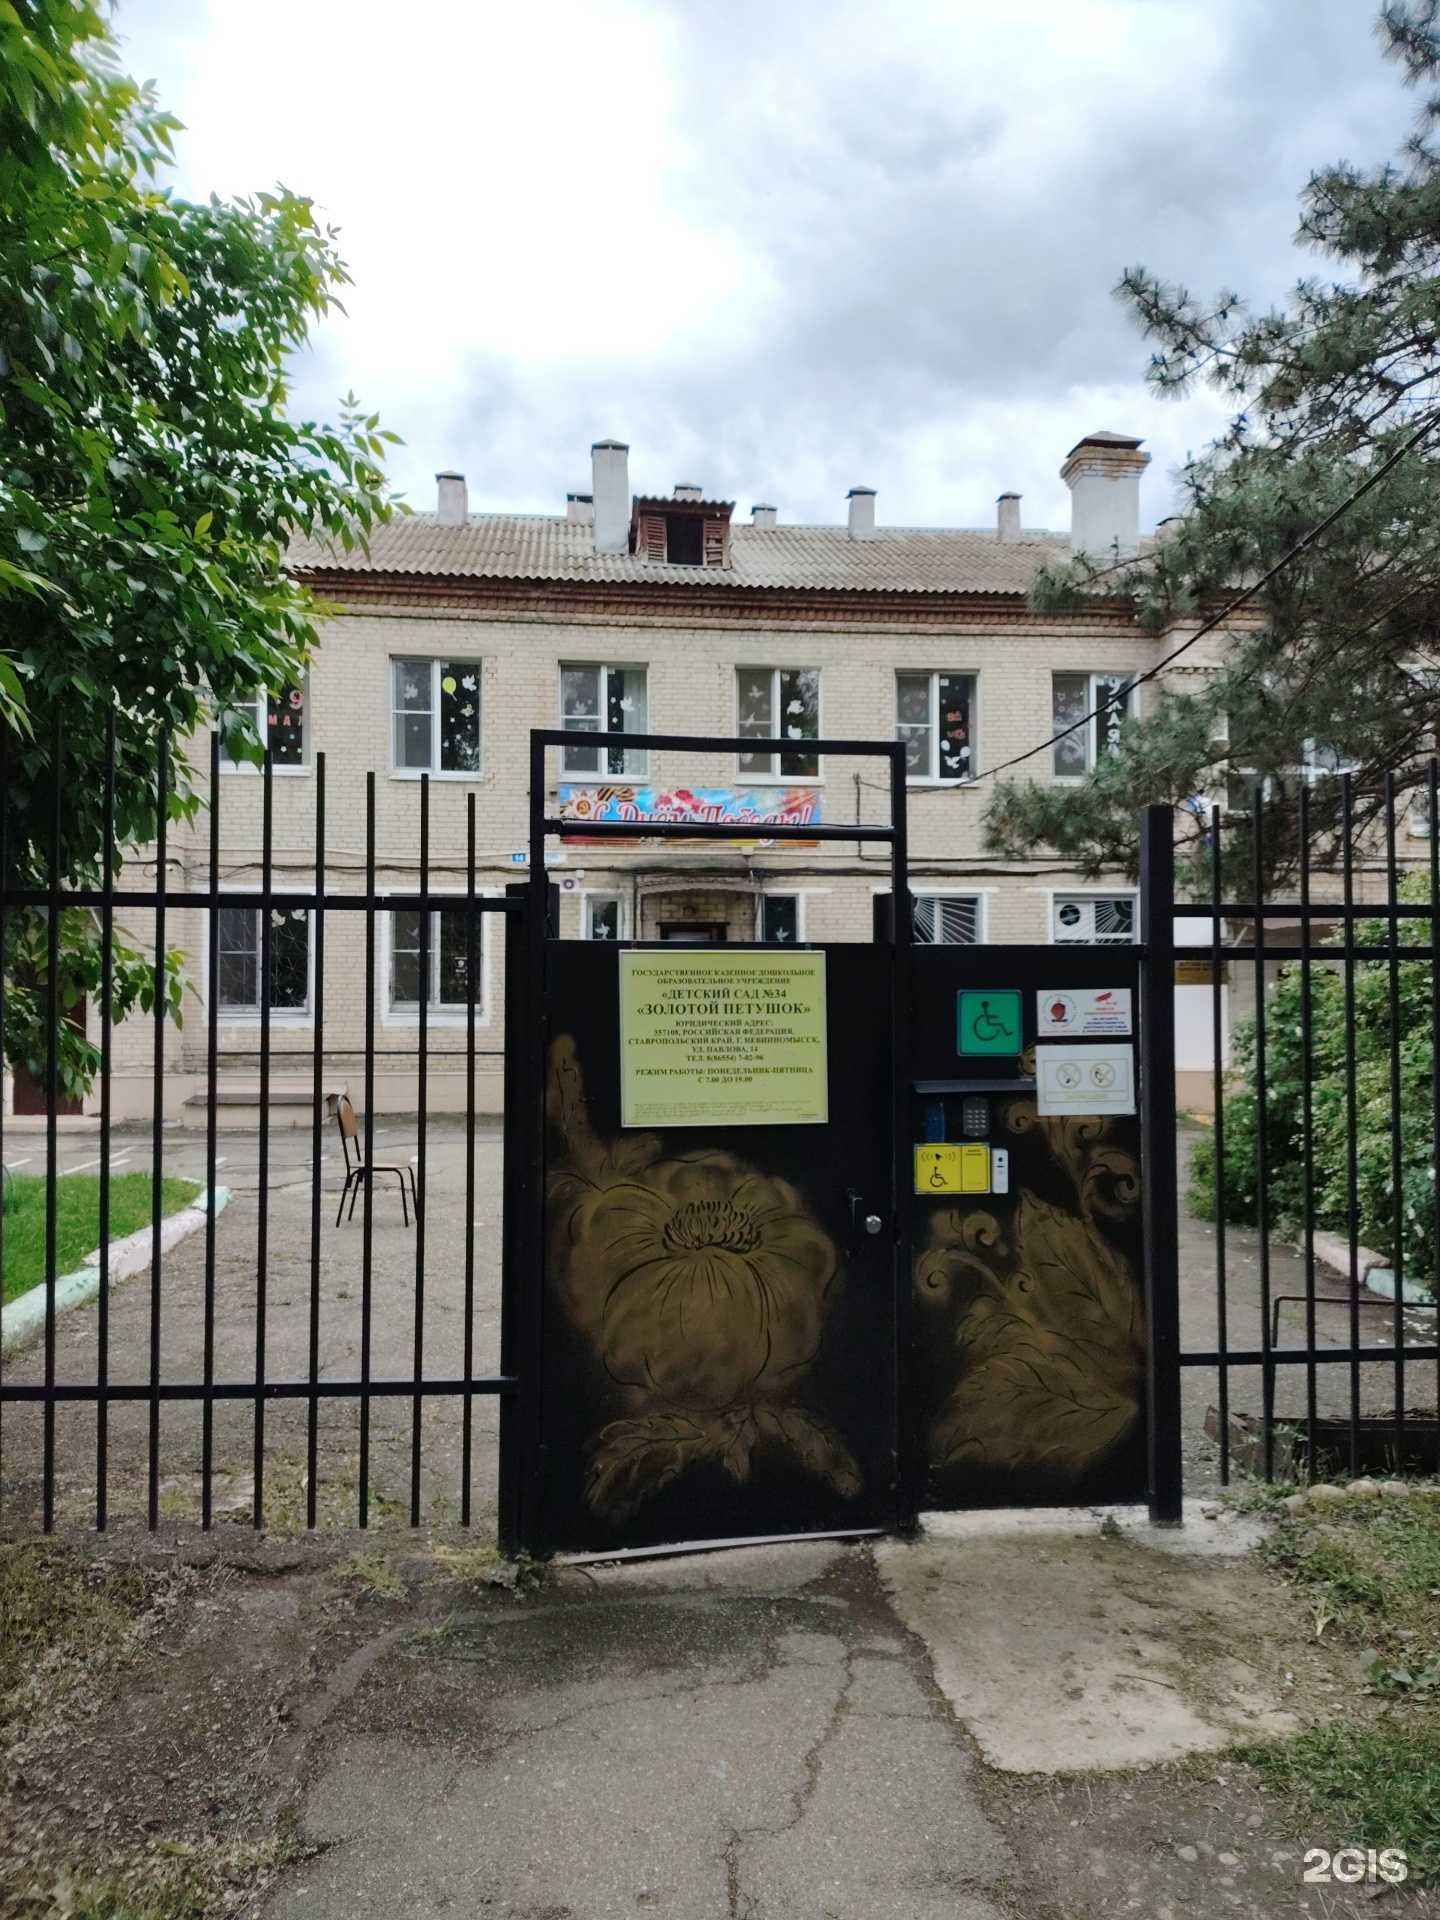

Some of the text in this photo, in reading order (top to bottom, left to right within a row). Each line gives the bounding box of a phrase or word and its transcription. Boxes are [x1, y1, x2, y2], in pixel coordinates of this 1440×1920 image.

[632, 968, 712, 977] ГОСУДАРСТВЕННОЕ
[758, 968, 816, 976] ДОШКОЛЬНОЕ
[657, 977, 791, 985] ОБРАЗОВАТЕЛЬНОЕ УЧРЕЖДЕНИЕ
[662, 987, 787, 1000] «ДЕТСКИЙ САД №34
[637, 1000, 811, 1015] «ЗОЛОТОЙ ПЕТУШОК»
[675, 1019, 743, 1027] ЮРИДИЧЕСКИЙ
[683, 1027, 741, 1036] РОССИЙСКАЯ
[628, 1037, 709, 1045] СТАВРОПОЛЬСКИЙ
[635, 1068, 668, 1076] РЕЖИМ
